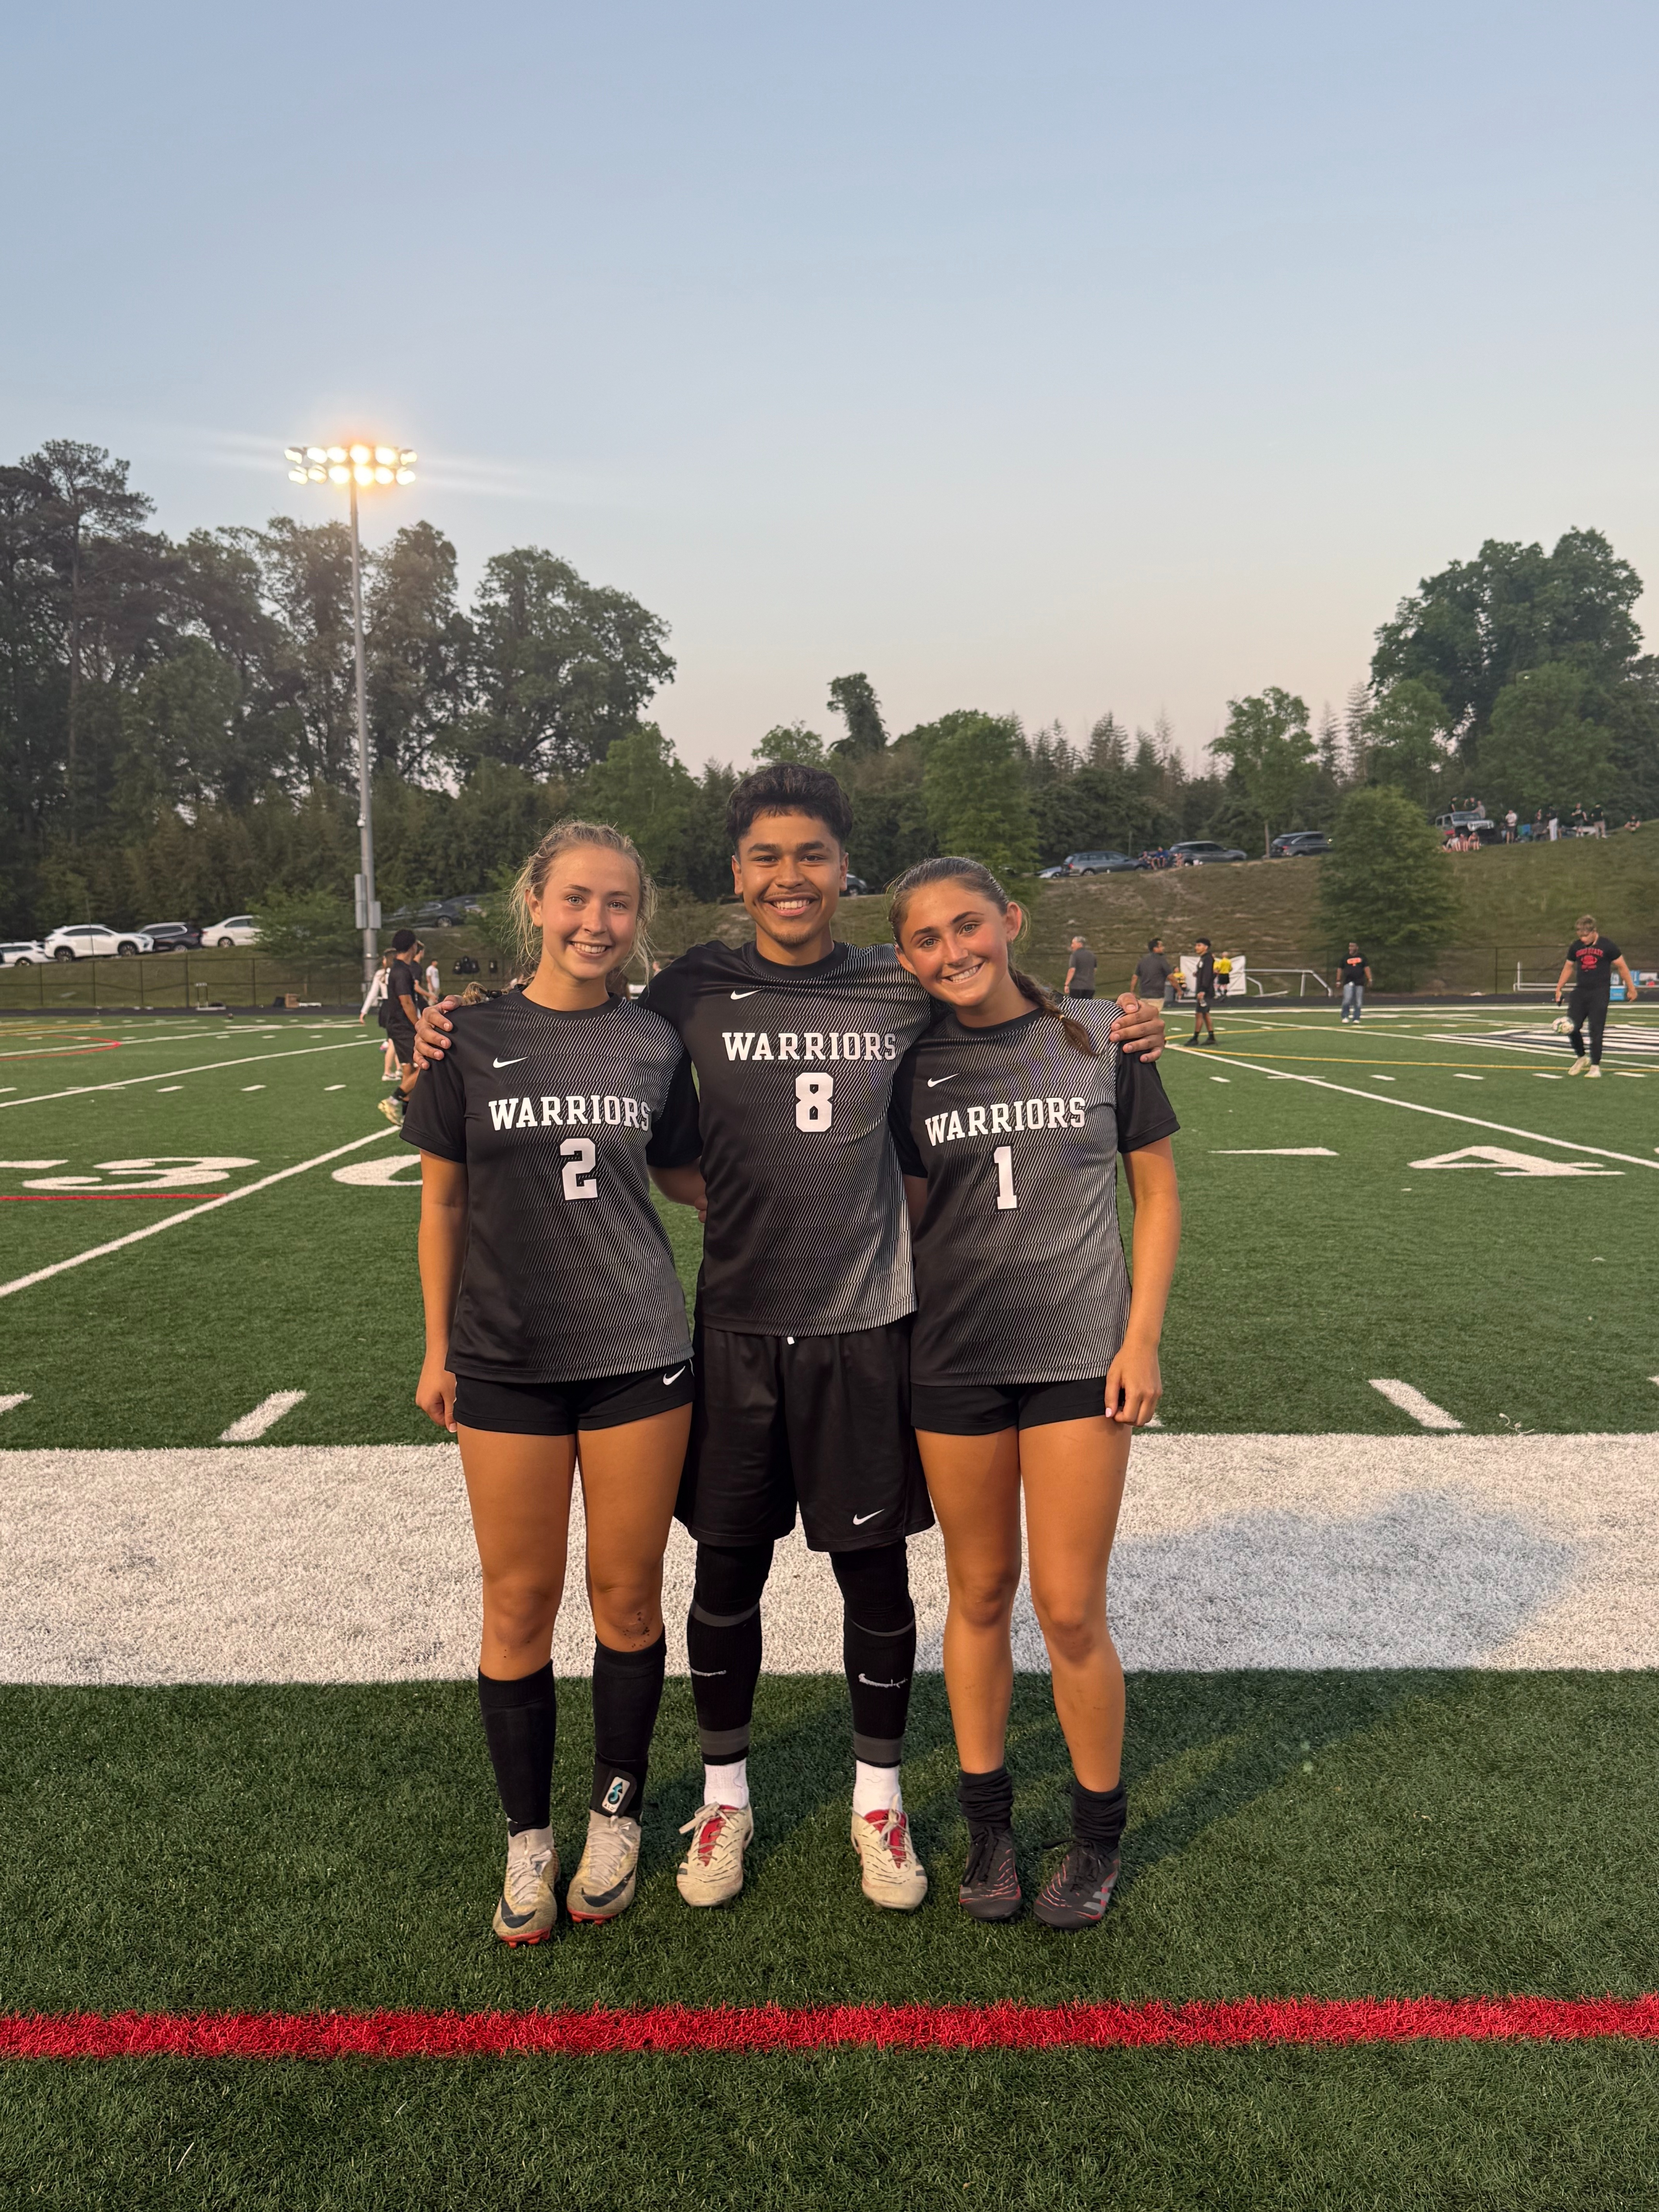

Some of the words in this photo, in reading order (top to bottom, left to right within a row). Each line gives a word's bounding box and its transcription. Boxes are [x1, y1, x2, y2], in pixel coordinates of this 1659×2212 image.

[722, 1032, 897, 1061] WARRIORS
[488, 1094, 652, 1132] WARRIORS
[795, 1072, 834, 1133] 8
[924, 1097, 1086, 1147] WARRIORS
[559, 1138, 598, 1201] 2
[993, 1145, 1017, 1210] 1
